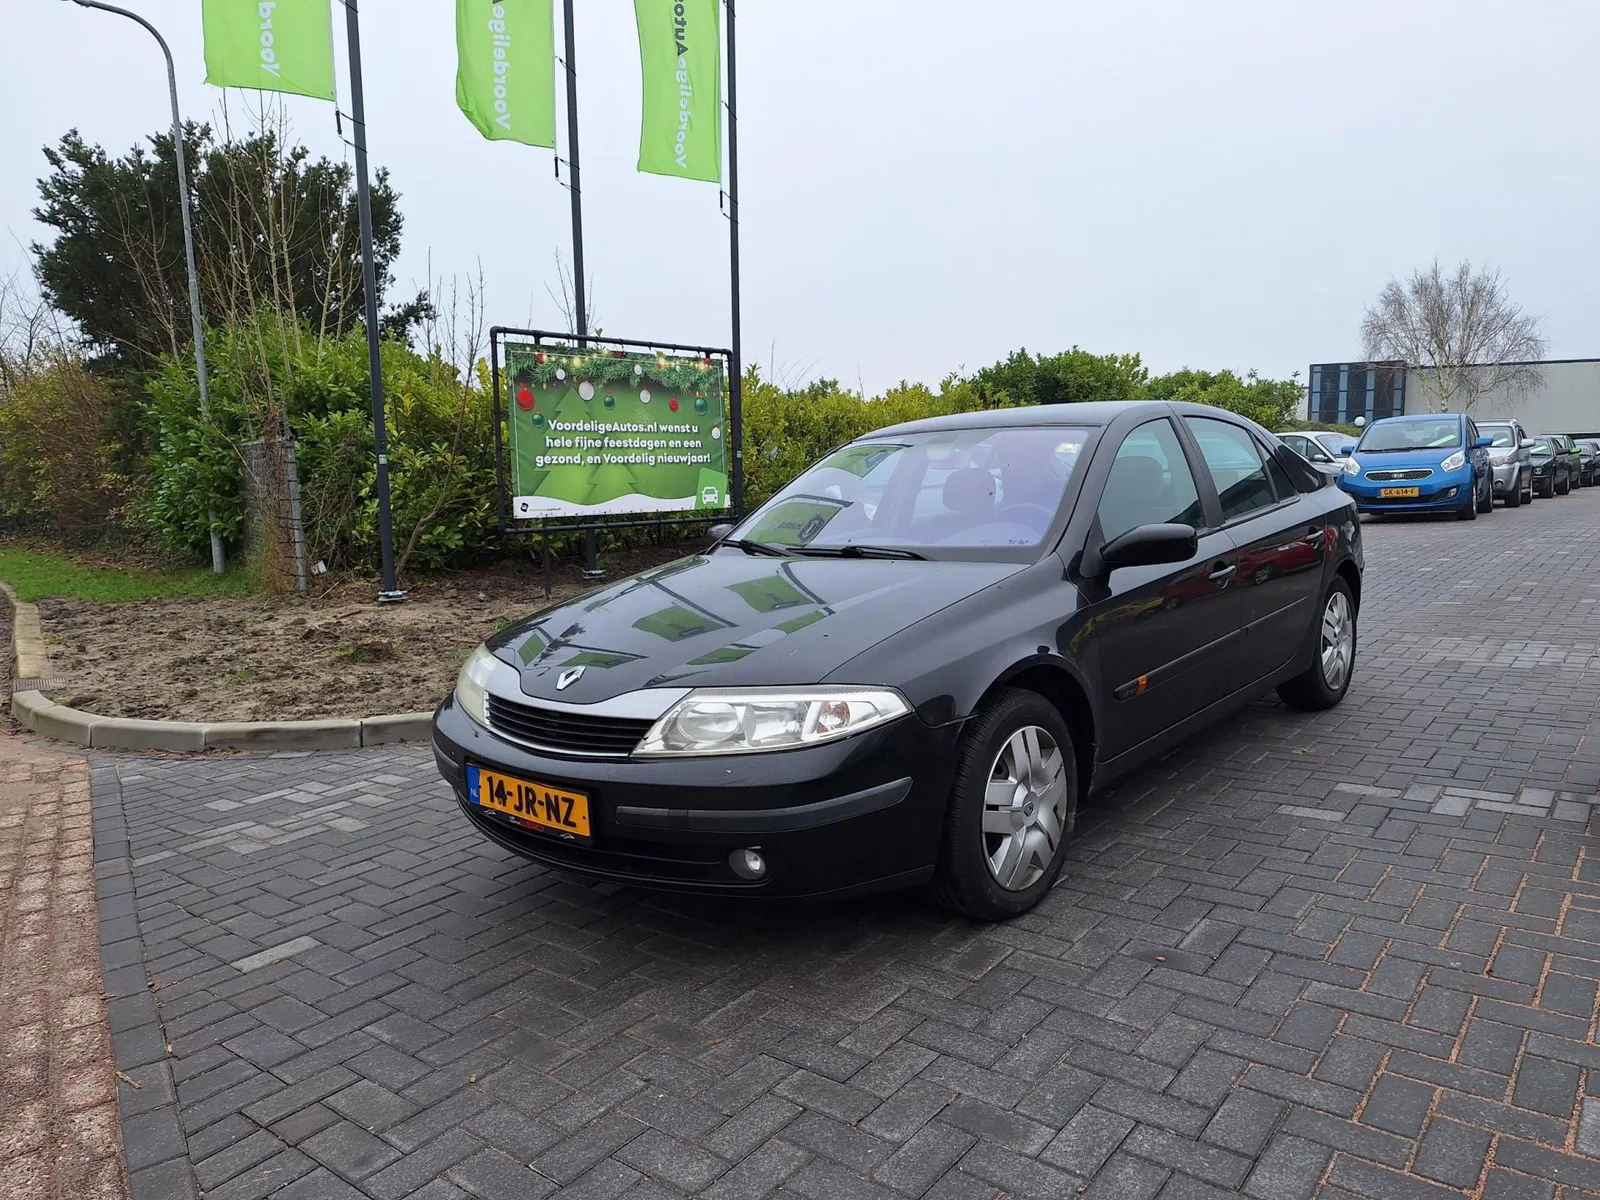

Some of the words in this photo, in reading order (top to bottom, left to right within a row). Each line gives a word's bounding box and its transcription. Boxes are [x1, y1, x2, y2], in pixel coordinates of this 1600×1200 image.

[548, 420, 657, 434] VoordeligeAutos.nl
[660, 423, 690, 433] wenst
[692, 425, 698, 433] u
[546, 436, 572, 447] hele
[575, 436, 601, 450] fijne
[604, 437, 666, 450] feestdagen
[669, 440, 681, 448] en
[683, 440, 702, 448] een
[535, 453, 585, 467] gezond,
[587, 455, 601, 464] en
[603, 453, 655, 466] Voordelig
[657, 452, 711, 465] nieuwjaar!
[470, 787, 479, 798] NL
[486, 775, 577, 828] 14-JR-NZ
